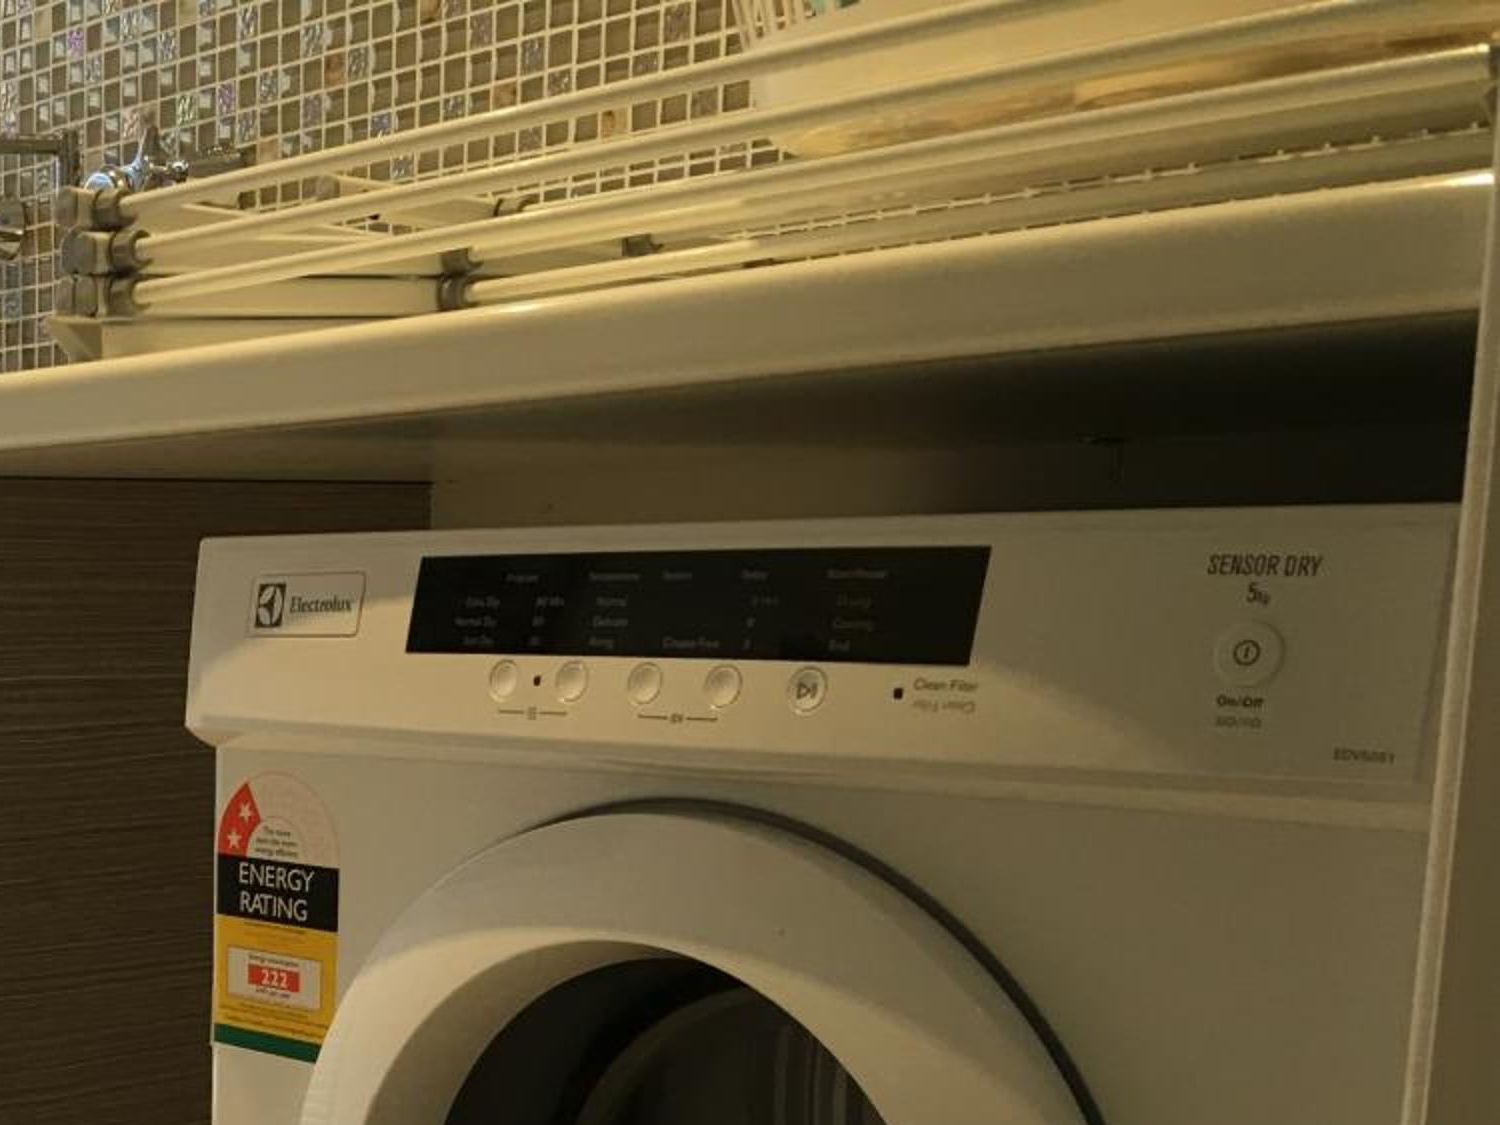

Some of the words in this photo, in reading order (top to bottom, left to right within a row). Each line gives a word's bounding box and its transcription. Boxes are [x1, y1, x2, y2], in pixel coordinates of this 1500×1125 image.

[1208, 554, 1280, 576] SENSOR
[1284, 555, 1324, 577] DRY
[289, 595, 352, 613] Electrolux
[914, 677, 947, 691] Clean
[1215, 694, 1264, 708] On/Off
[239, 861, 315, 893] ENERGY
[239, 891, 308, 922] RATING
[261, 969, 288, 989] 222
